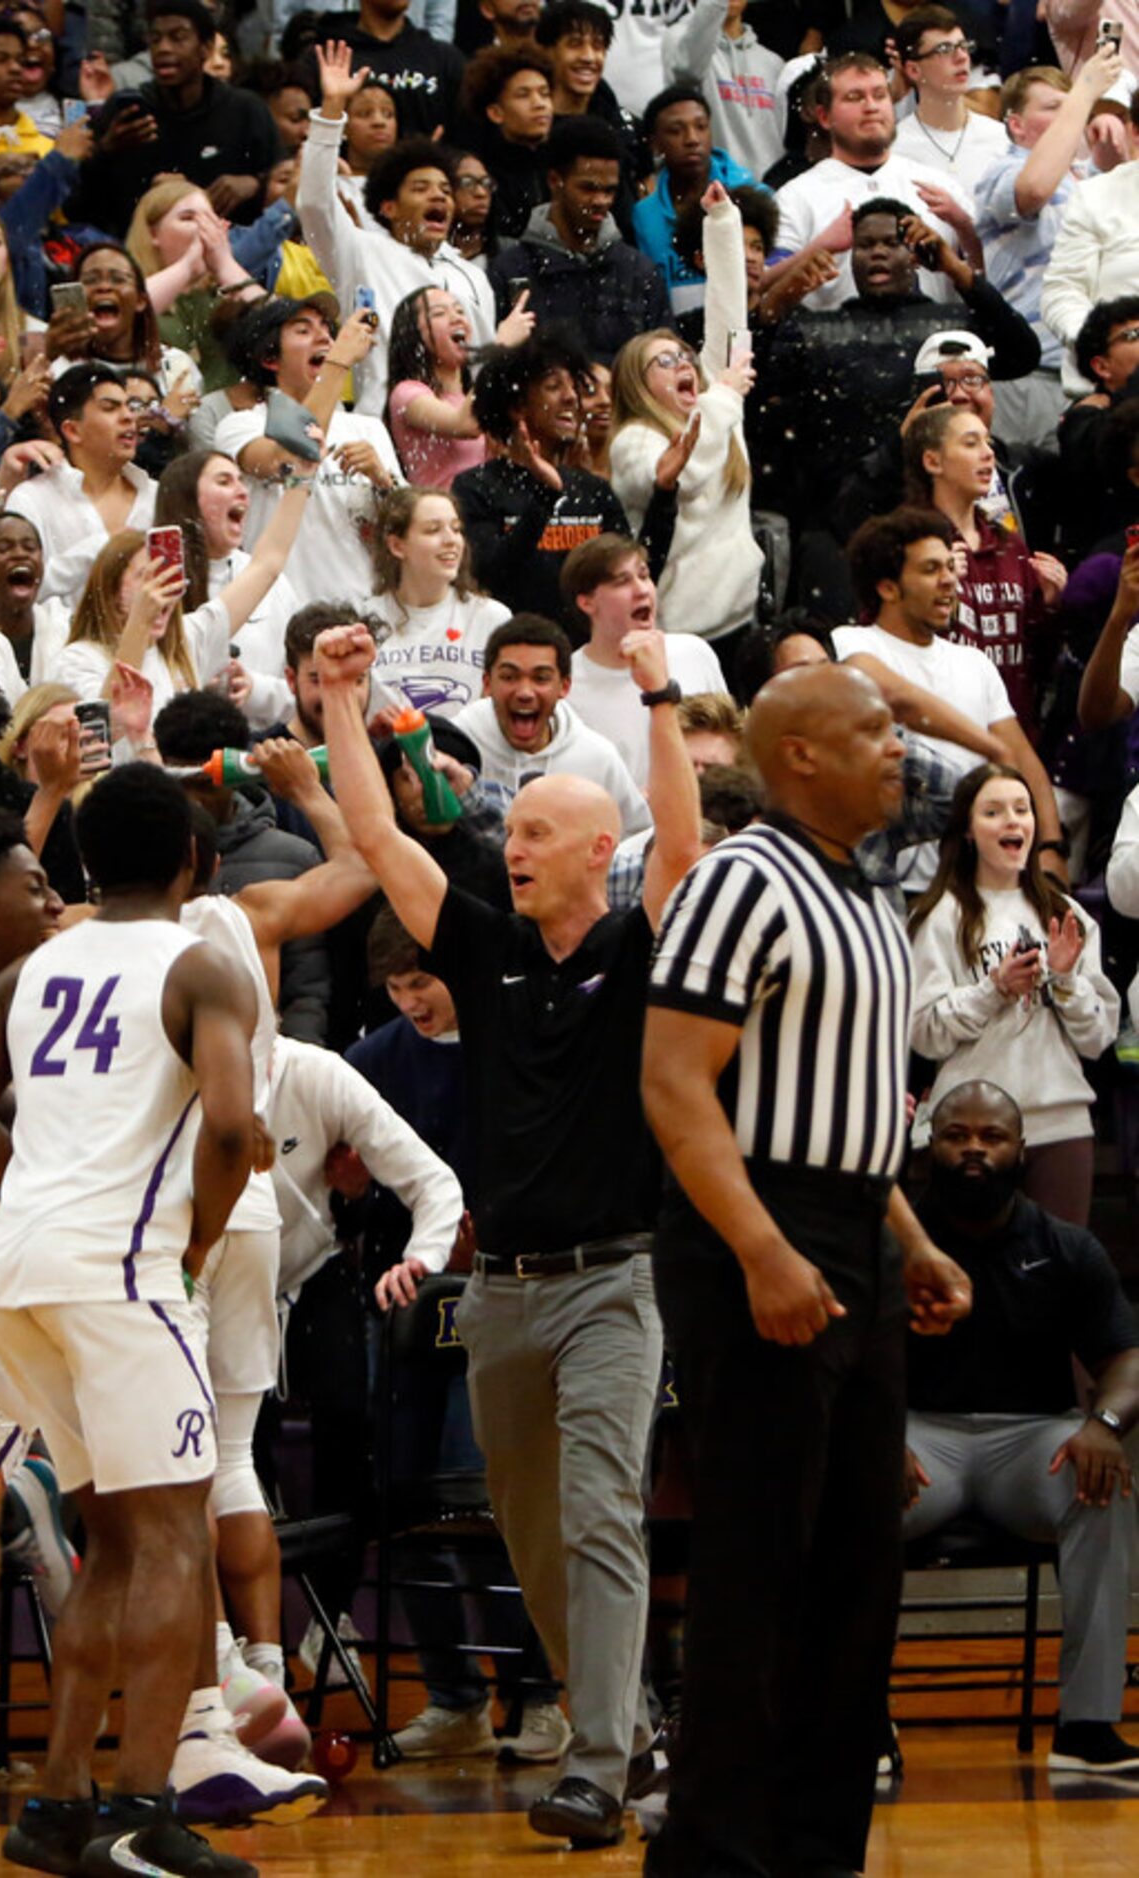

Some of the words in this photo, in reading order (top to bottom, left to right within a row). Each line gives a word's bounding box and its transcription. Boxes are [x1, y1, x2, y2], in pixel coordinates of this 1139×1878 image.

[375, 645, 415, 668] ADY
[419, 645, 485, 669] EAGLE
[30, 974, 121, 1076] 24
[171, 1408, 205, 1458] R
